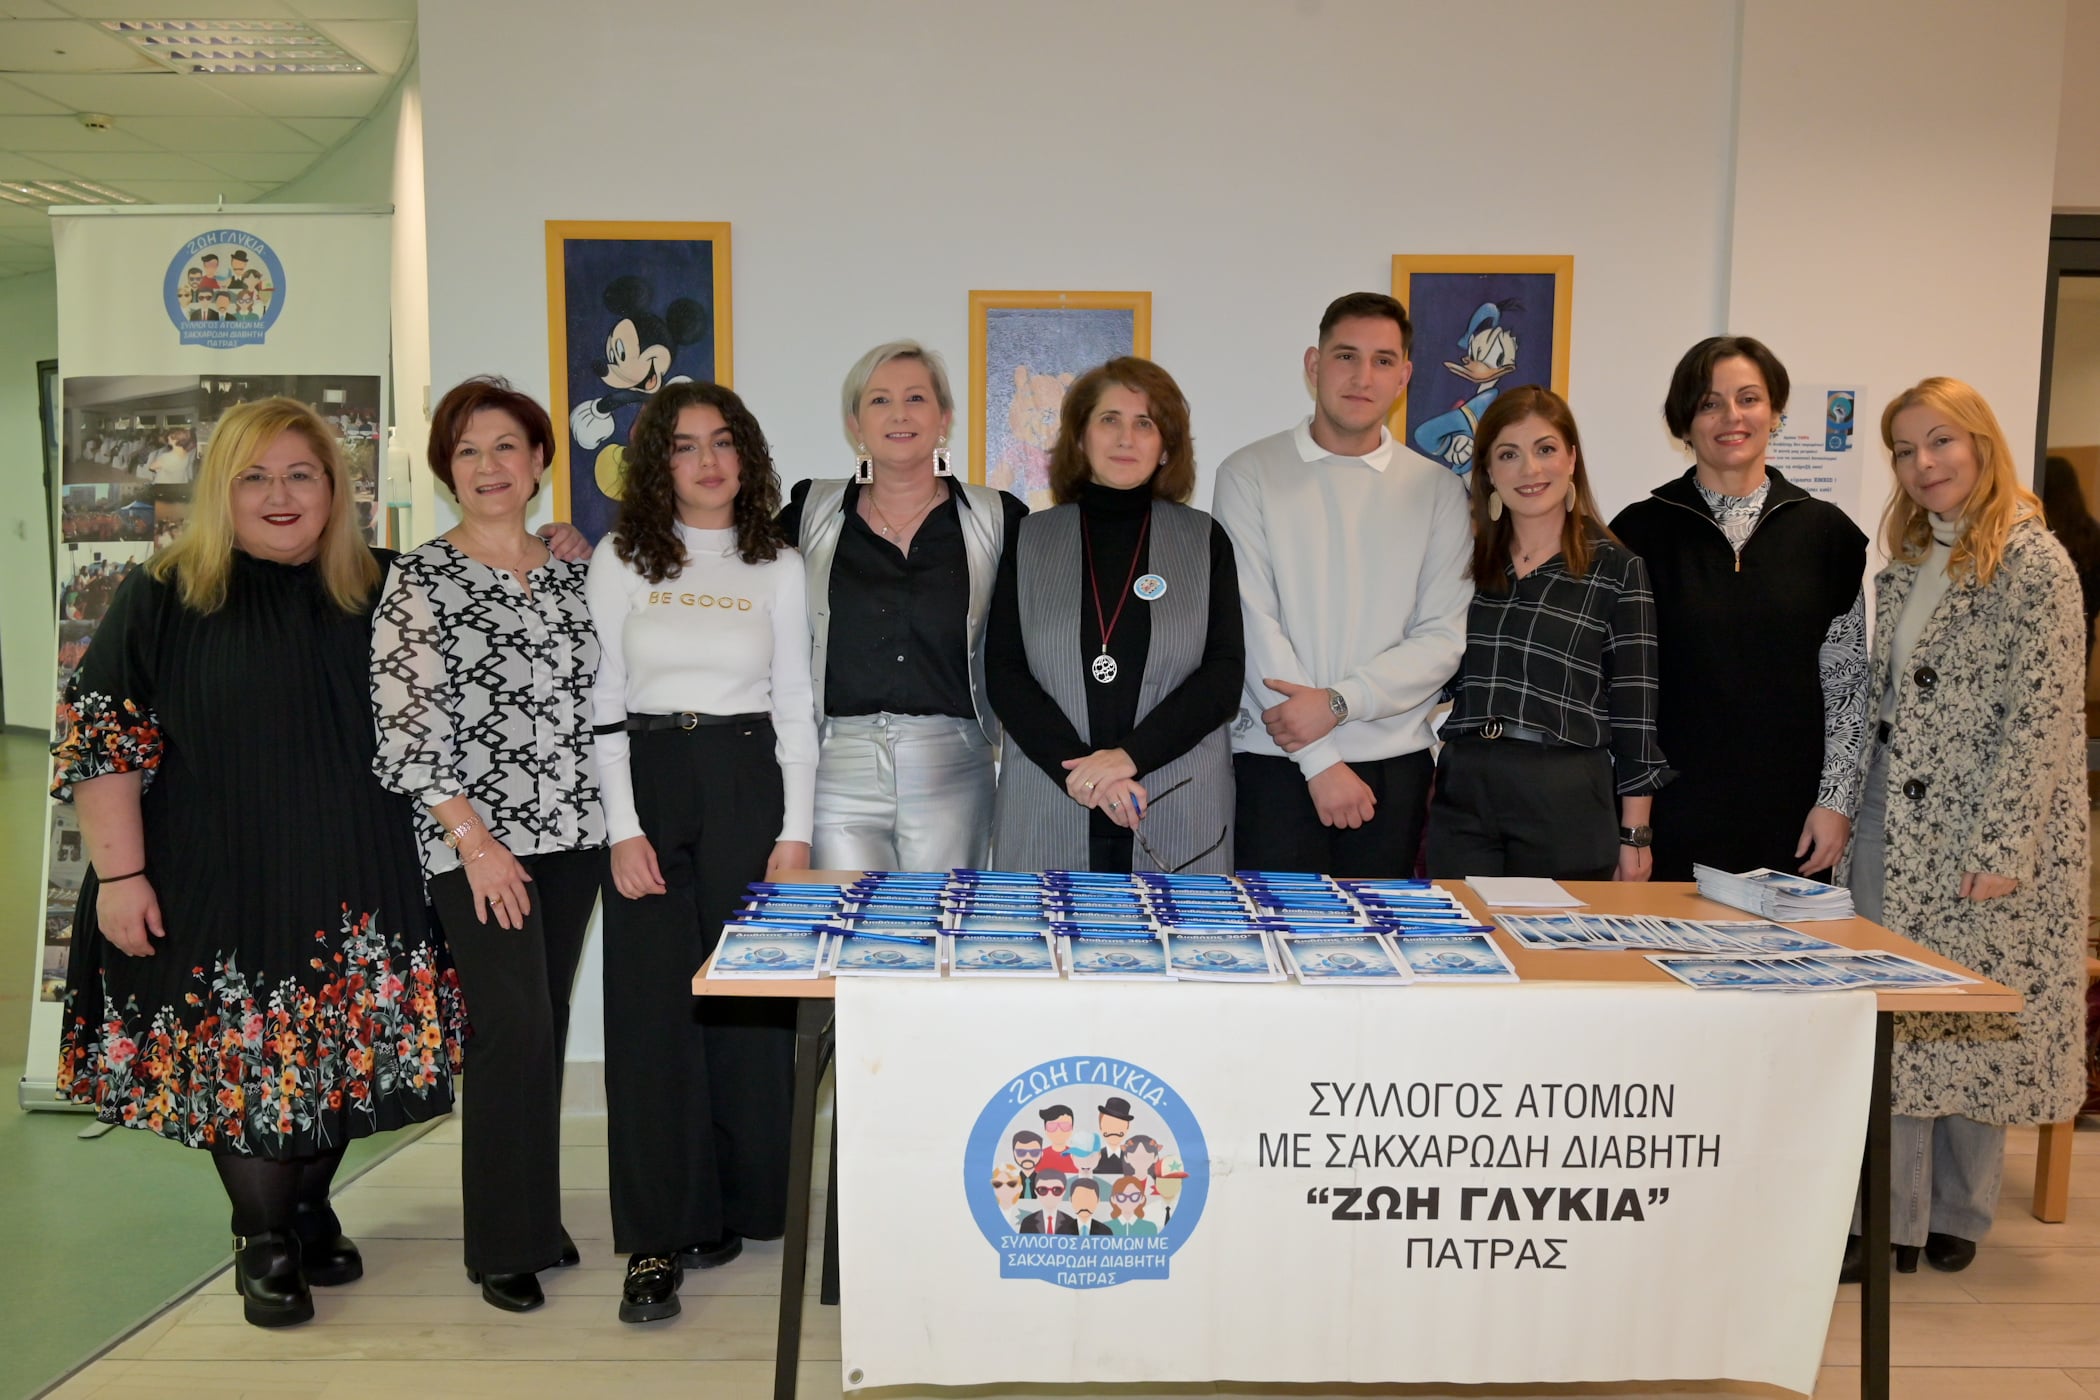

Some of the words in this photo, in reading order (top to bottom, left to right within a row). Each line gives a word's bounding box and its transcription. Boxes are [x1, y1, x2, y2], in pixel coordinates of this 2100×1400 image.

[187, 232, 216, 254] ΖΩΗ
[220, 231, 265, 254] ΓΛΥΚΙΑ
[649, 591, 673, 604] BE
[679, 593, 752, 611] GOOD
[1009, 1062, 1068, 1104] ΖΩΗ
[1075, 1060, 1165, 1106] ΓΛΥΚΙΑ
[1309, 1082, 1503, 1119] ΣΥΛΛΟΓΟΣ
[1515, 1083, 1675, 1119] ΑΤΟΜΩΝ
[1259, 1132, 1312, 1169] ΜΕ
[1324, 1133, 1549, 1169] ΣΑΚΧΑΡΩΔΗ
[1560, 1134, 1721, 1169] ΔΙΑΒΗΤΗ
[1001, 1235, 1078, 1250] ΣΥΛΛΟΓΟΣ
[1080, 1237, 1144, 1251] ΑΤΟΜΩΝ
[1147, 1237, 1169, 1250] ΜΕ
[1406, 1237, 1568, 1271] ΠΑΤΡΑΣ
[1008, 1253, 1097, 1268] ΣΑΚΧΑΡΩΔΗ
[1100, 1255, 1166, 1268] ΔΙΑΒΗΤΗ
[1057, 1272, 1117, 1286] ΠΑΤΡΑΣ
